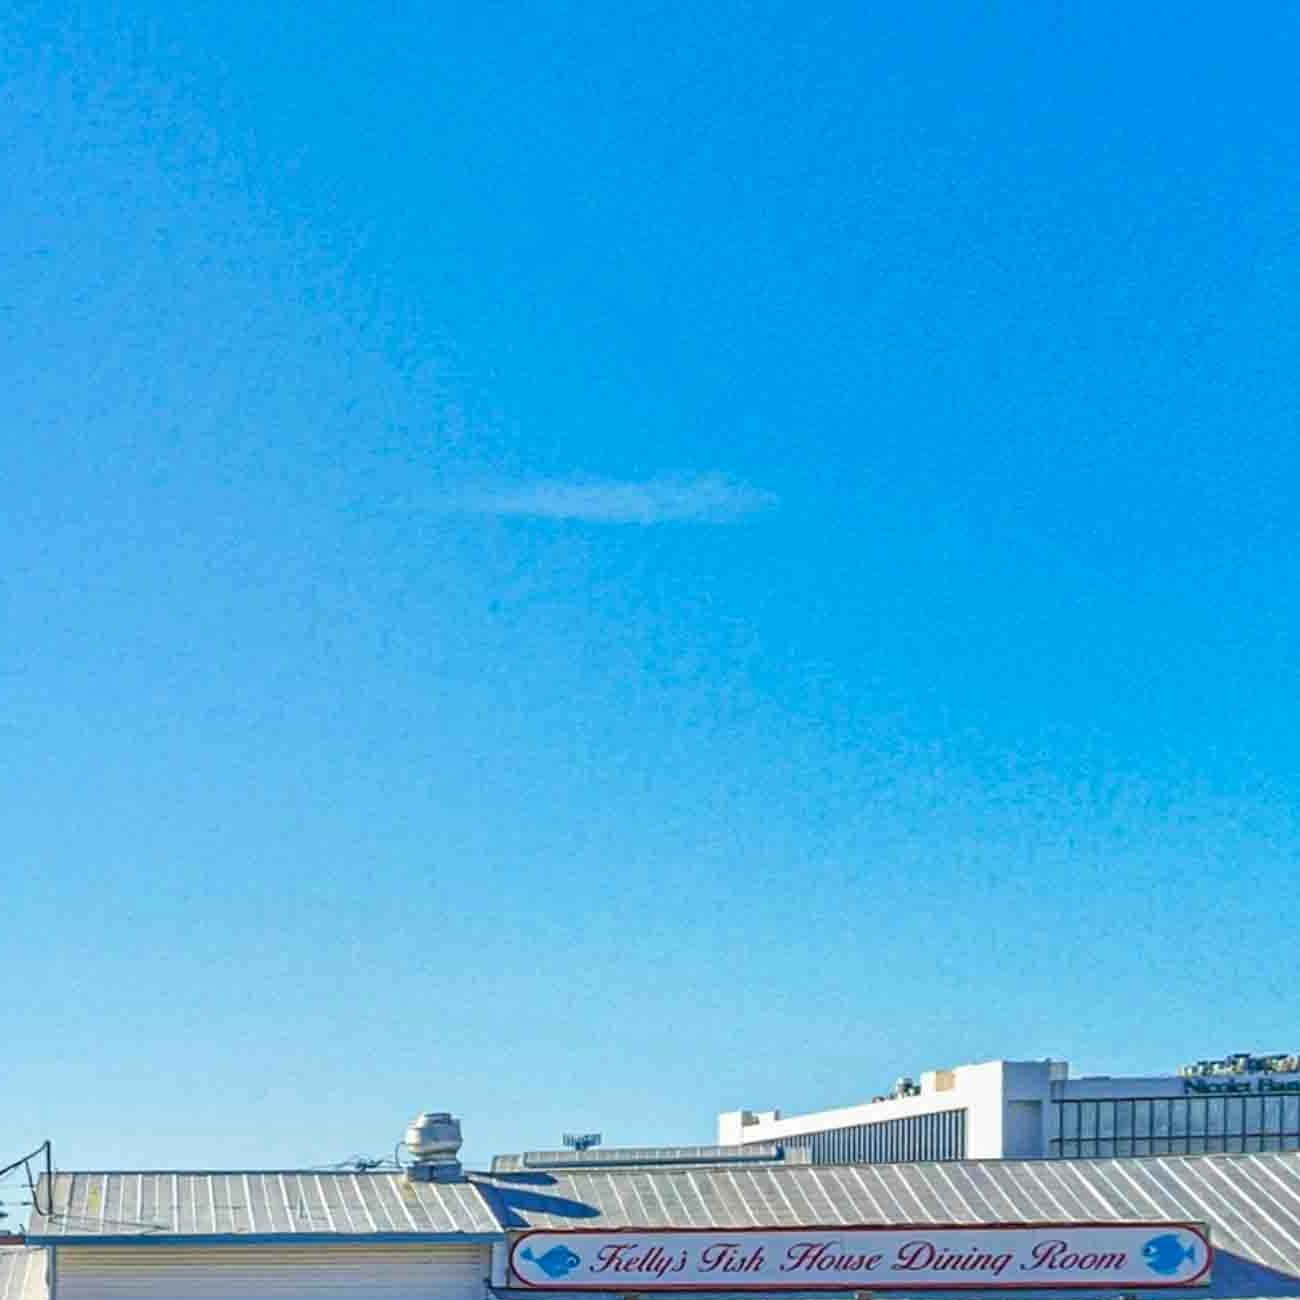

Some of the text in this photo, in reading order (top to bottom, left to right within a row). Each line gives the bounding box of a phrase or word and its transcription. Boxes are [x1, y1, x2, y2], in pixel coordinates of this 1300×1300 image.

[588, 1239, 1129, 1279] Kelly's Fish House Dining Room
